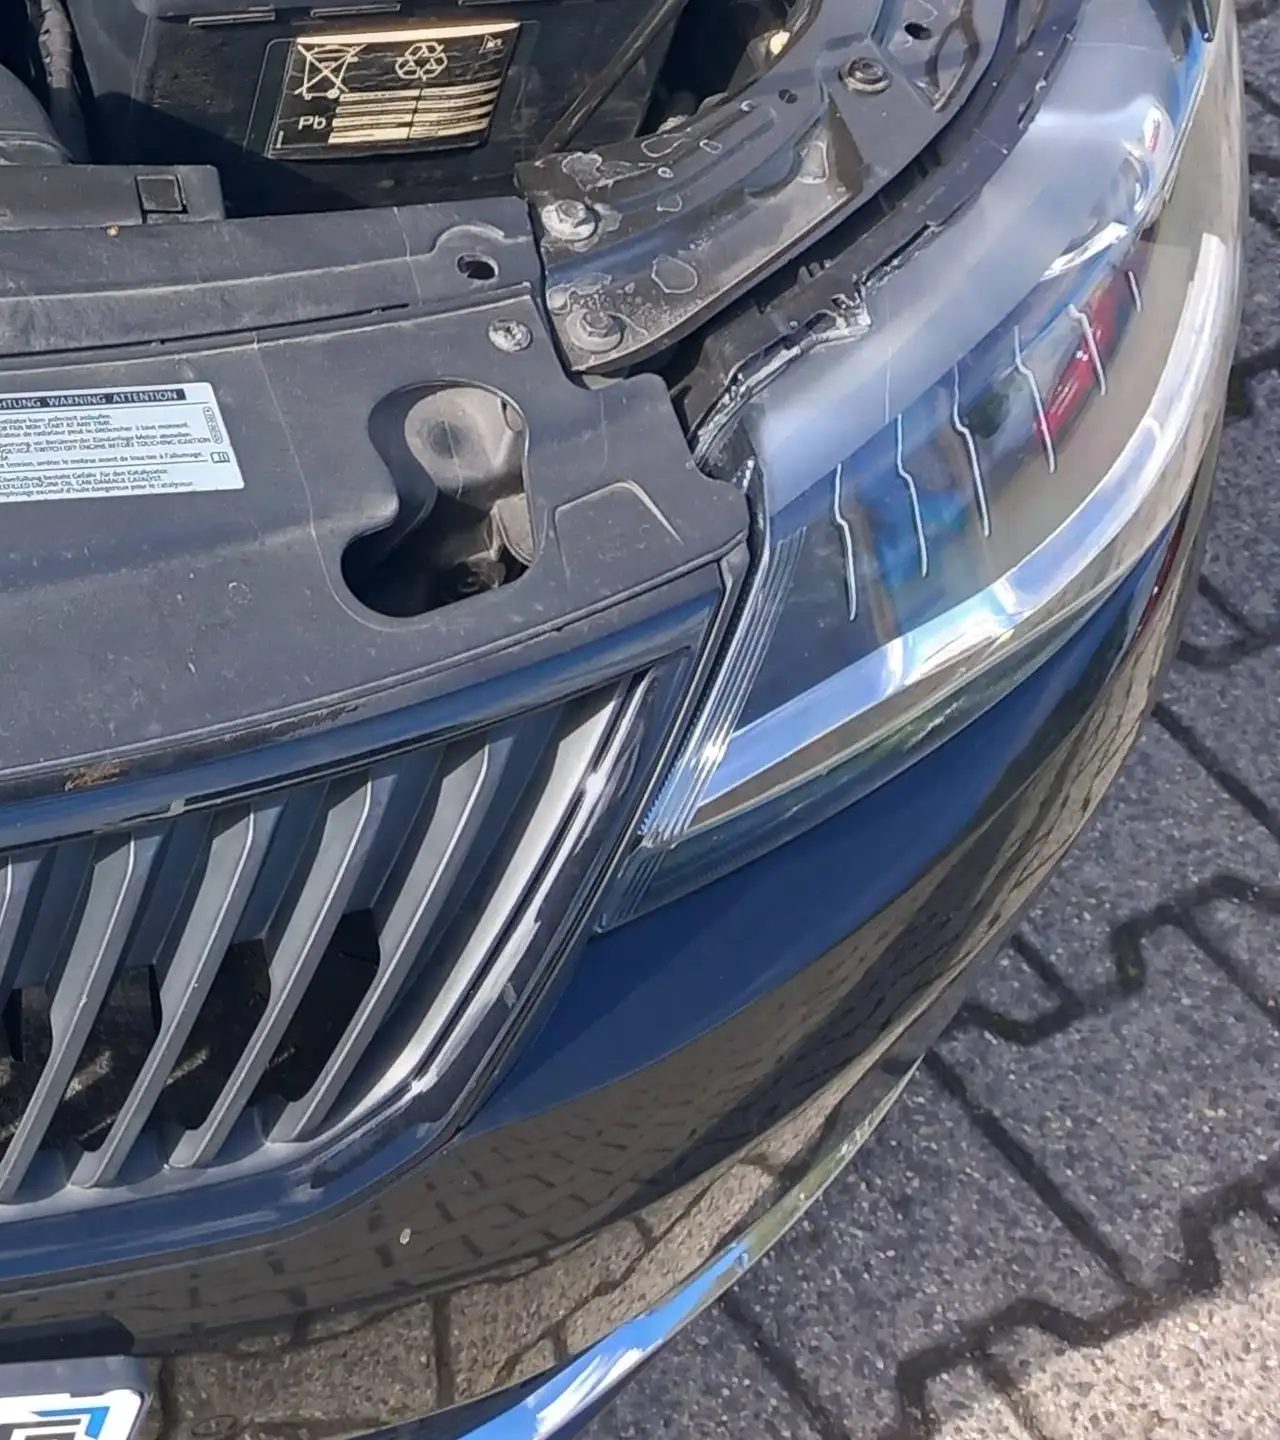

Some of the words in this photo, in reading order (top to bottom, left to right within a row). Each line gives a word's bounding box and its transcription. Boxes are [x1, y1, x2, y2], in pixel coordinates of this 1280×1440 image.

[298, 115, 327, 131] Pb
[46, 395, 105, 405] WARNING
[111, 391, 178, 402] ATTENTION
